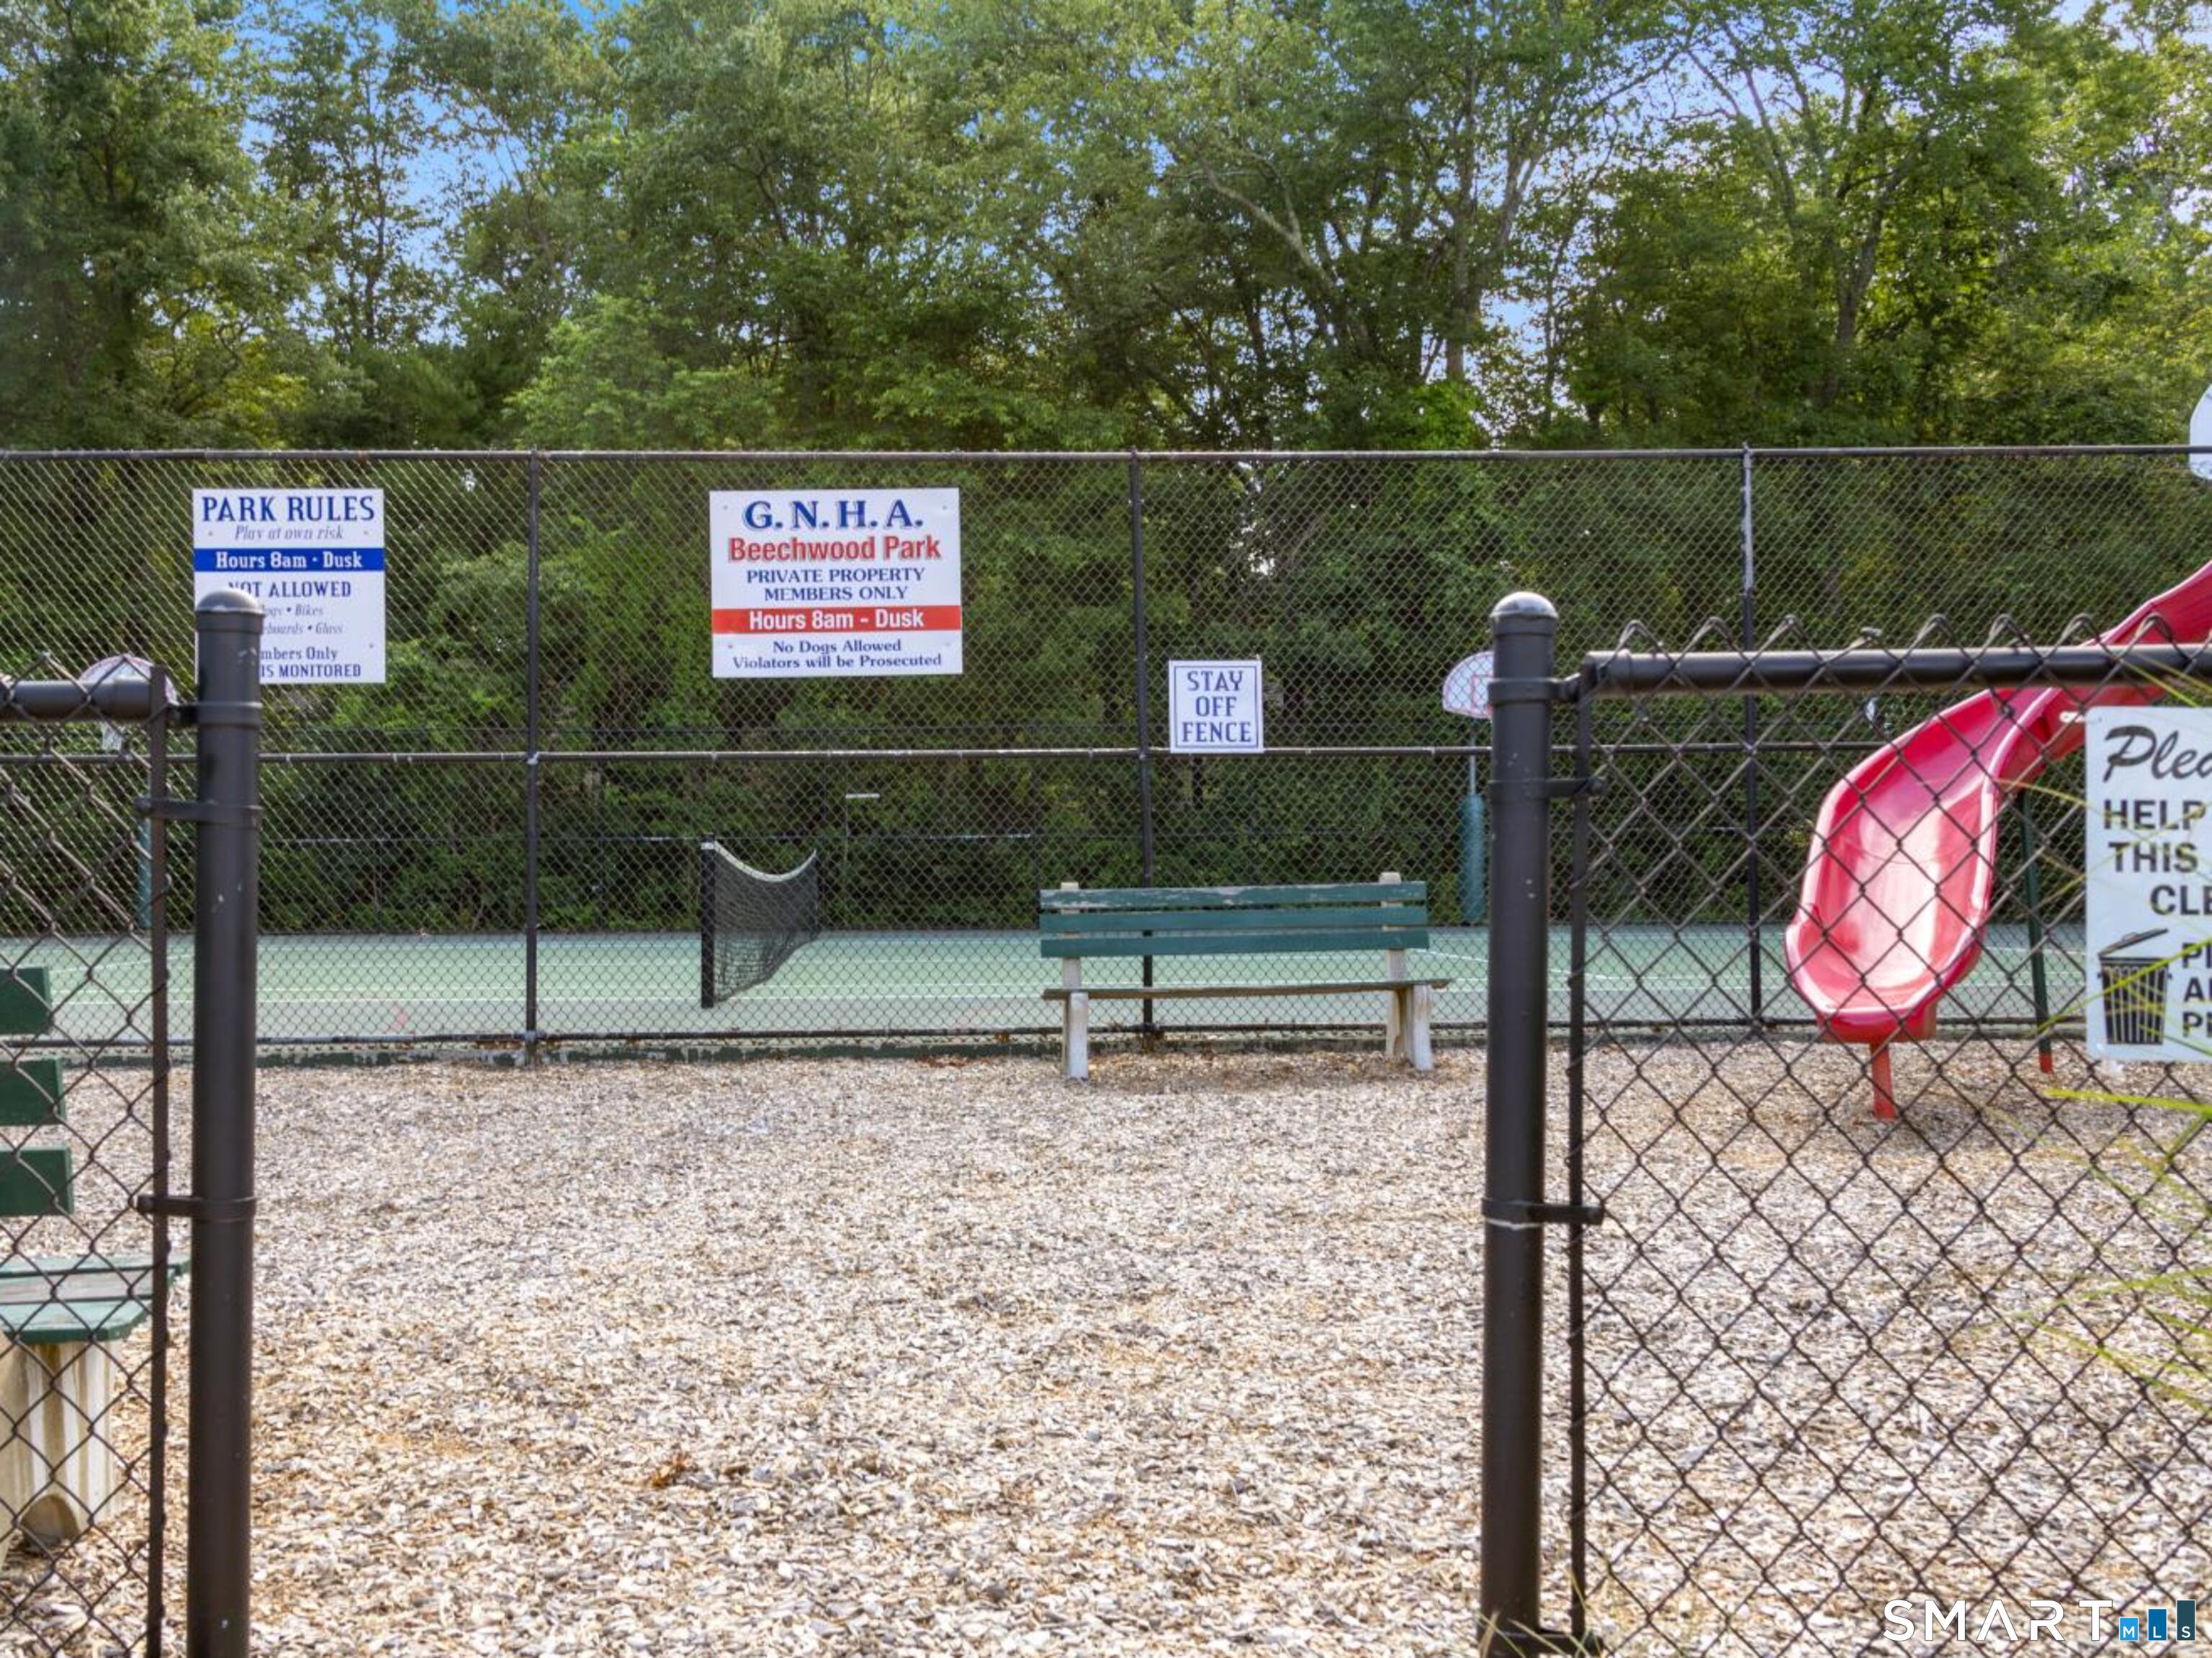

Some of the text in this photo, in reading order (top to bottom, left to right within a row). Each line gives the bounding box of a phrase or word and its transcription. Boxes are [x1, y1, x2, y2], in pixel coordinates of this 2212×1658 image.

[202, 495, 374, 522] PARK RULES
[742, 499, 924, 531] G.N.H.A.
[235, 525, 344, 541] Play at own risk
[728, 535, 943, 563] Beechwood Park
[216, 551, 265, 568] Hours
[270, 551, 307, 567] 8am
[323, 551, 363, 568] Dusk
[747, 567, 925, 584] PRIVATE PROPERTY
[269, 581, 351, 597] ALLOWED
[765, 585, 908, 601] MEMBERS ONLY
[295, 603, 323, 616] Bikes
[750, 611, 806, 630] Hours
[812, 610, 853, 629] 8am
[875, 608, 925, 628] Dusk
[315, 622, 343, 634] Glass
[261, 646, 338, 661] mbers Only
[773, 639, 901, 655] No Dogs Allowed
[733, 654, 942, 669] Violators will be Prosecuted
[279, 664, 361, 677] MONITORED
[1187, 670, 1244, 691] STAY
[1195, 696, 1237, 717] OFF
[1182, 722, 1251, 742] FENCE
[2103, 799, 2206, 829] HELP
[2108, 841, 2198, 873] THIS
